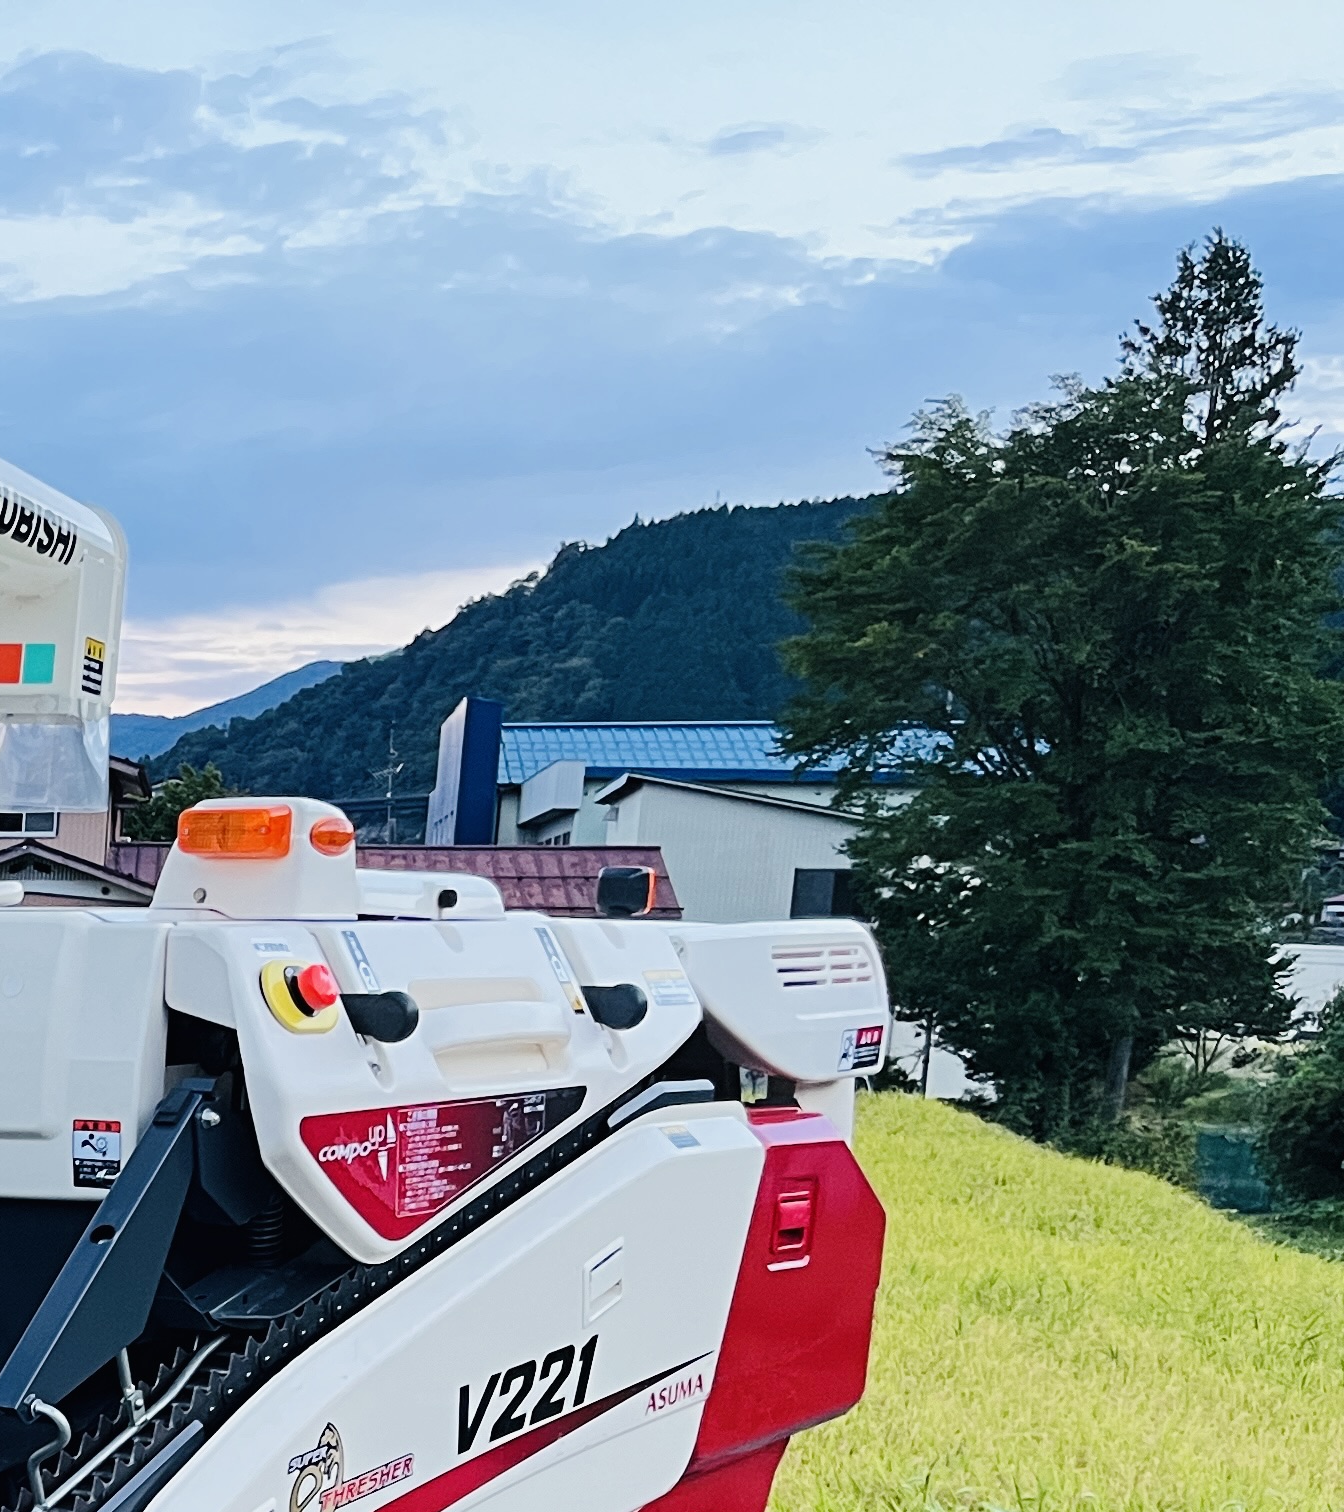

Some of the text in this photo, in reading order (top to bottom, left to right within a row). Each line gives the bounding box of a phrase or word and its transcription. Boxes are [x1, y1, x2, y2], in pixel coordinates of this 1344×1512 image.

[457, 1334, 599, 1455] V221
[644, 1373, 704, 1416] ASUMA
[320, 1456, 414, 1511] THRESHER
